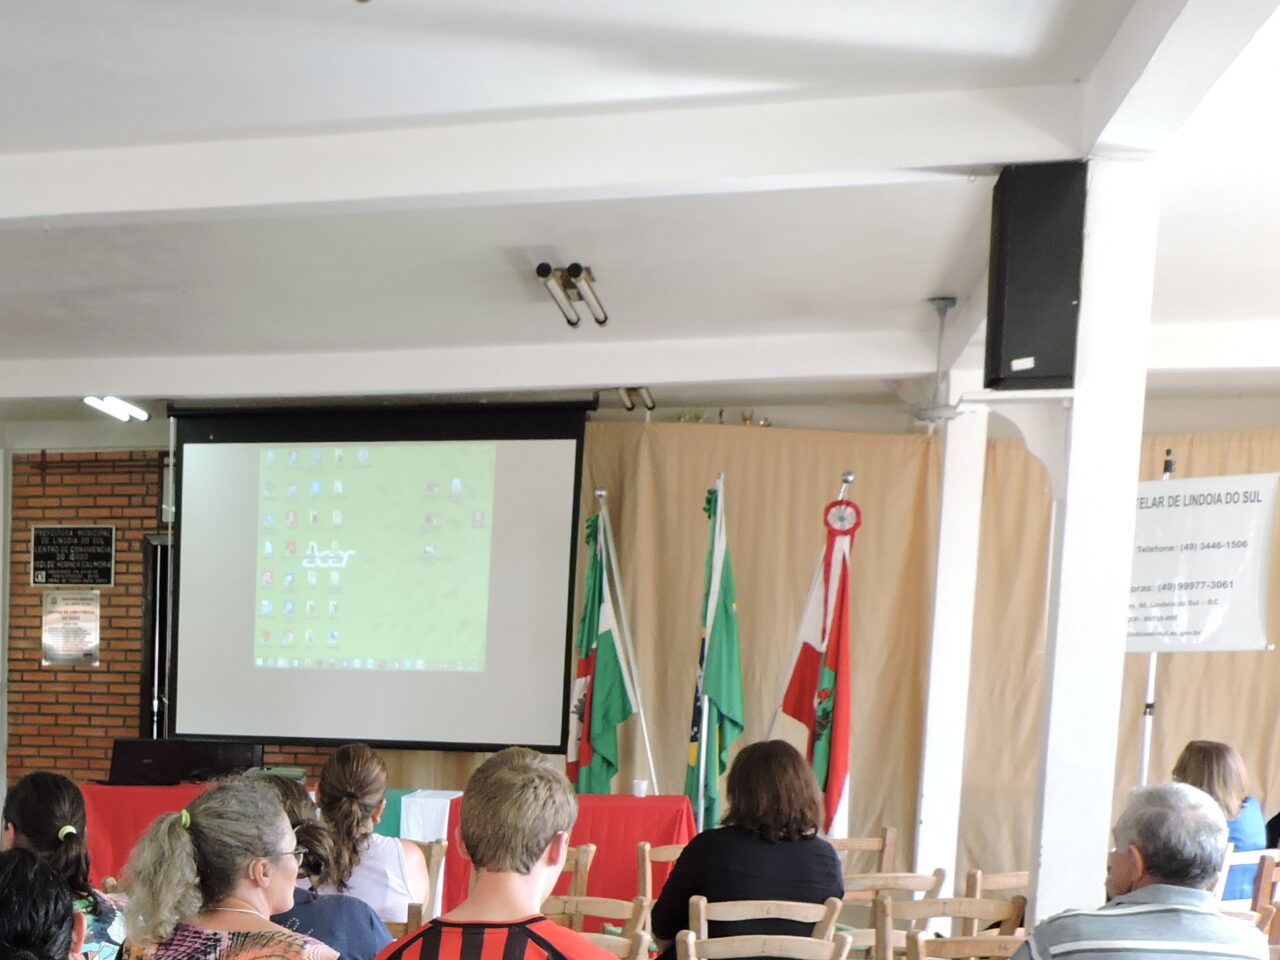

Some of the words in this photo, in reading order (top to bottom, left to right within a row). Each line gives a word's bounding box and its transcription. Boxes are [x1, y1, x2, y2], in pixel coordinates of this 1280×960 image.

[1167, 495, 1181, 507] DE
[1183, 493, 1223, 507] LINDOIA
[1225, 491, 1240, 504] DO
[1242, 490, 1263, 504] SUL
[1180, 542, 1197, 552] (49)
[1157, 582, 1177, 592] (49)
[1177, 580, 1234, 591] 99977-3061
